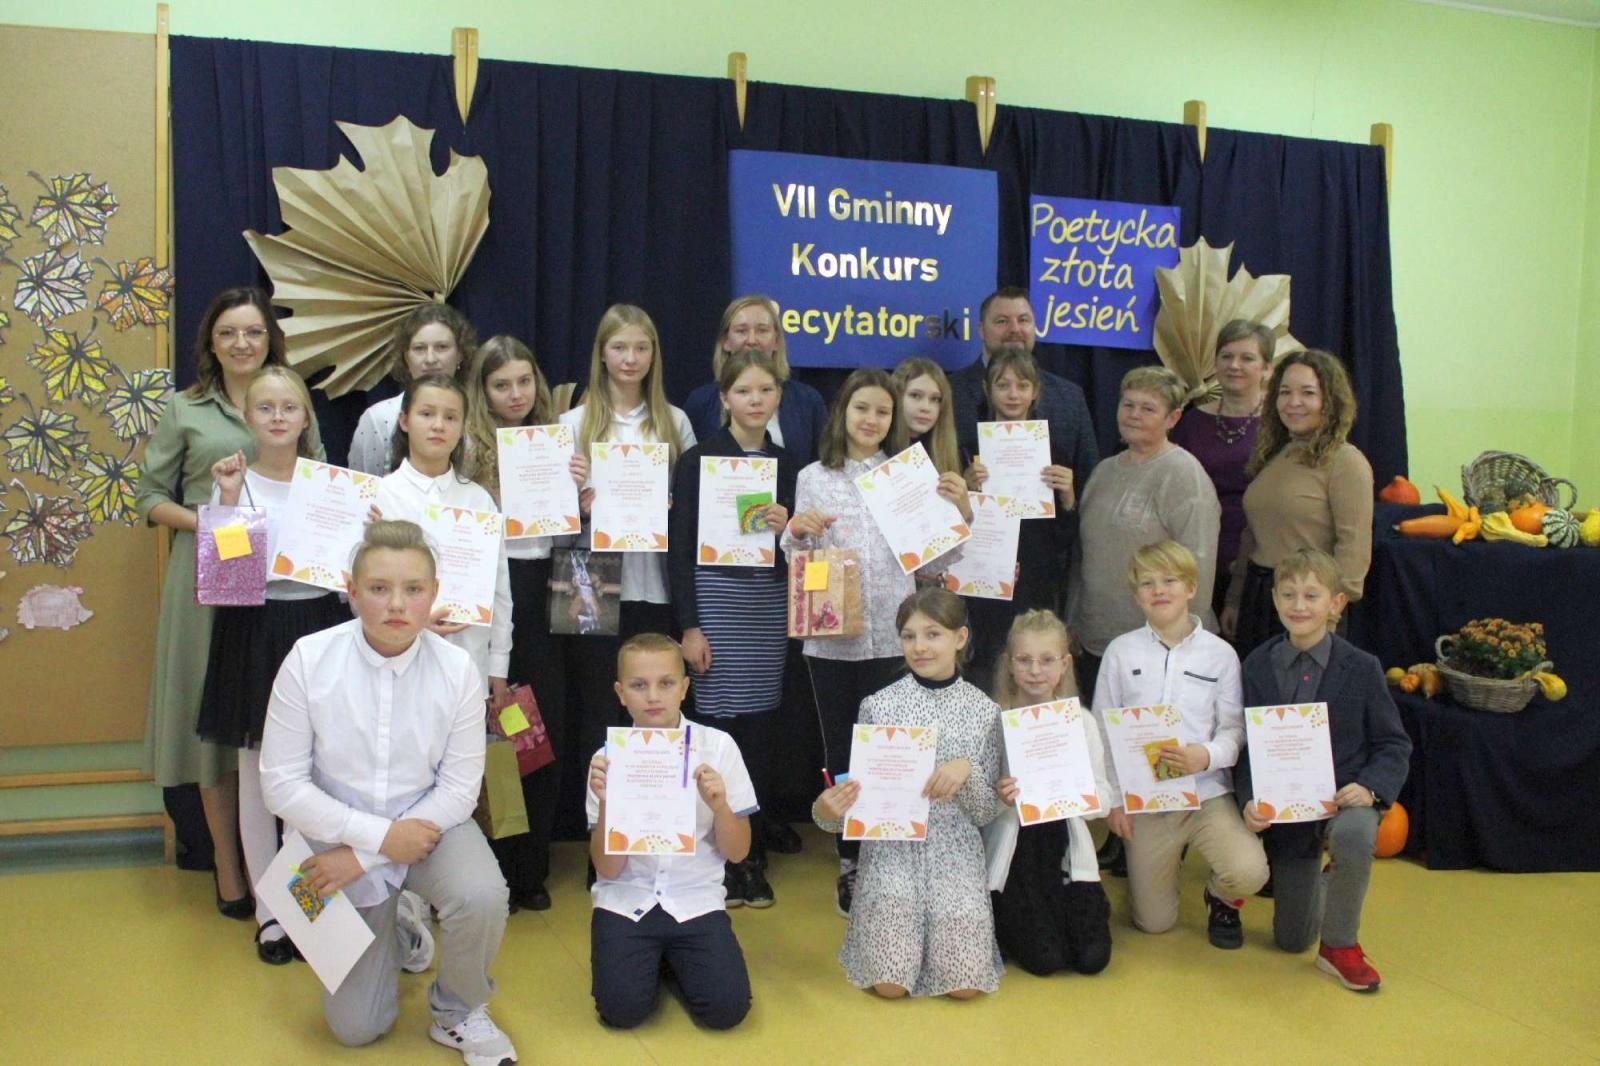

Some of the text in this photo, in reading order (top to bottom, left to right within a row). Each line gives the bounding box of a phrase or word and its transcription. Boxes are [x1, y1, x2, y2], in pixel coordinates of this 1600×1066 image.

[772, 183, 953, 235] VII Gminny
[1032, 203, 1178, 256] Poetycka
[791, 242, 939, 282] Konkurs
[1039, 246, 1135, 290] złota
[771, 300, 971, 344] ecytatorski
[1034, 294, 1141, 338] jesień
